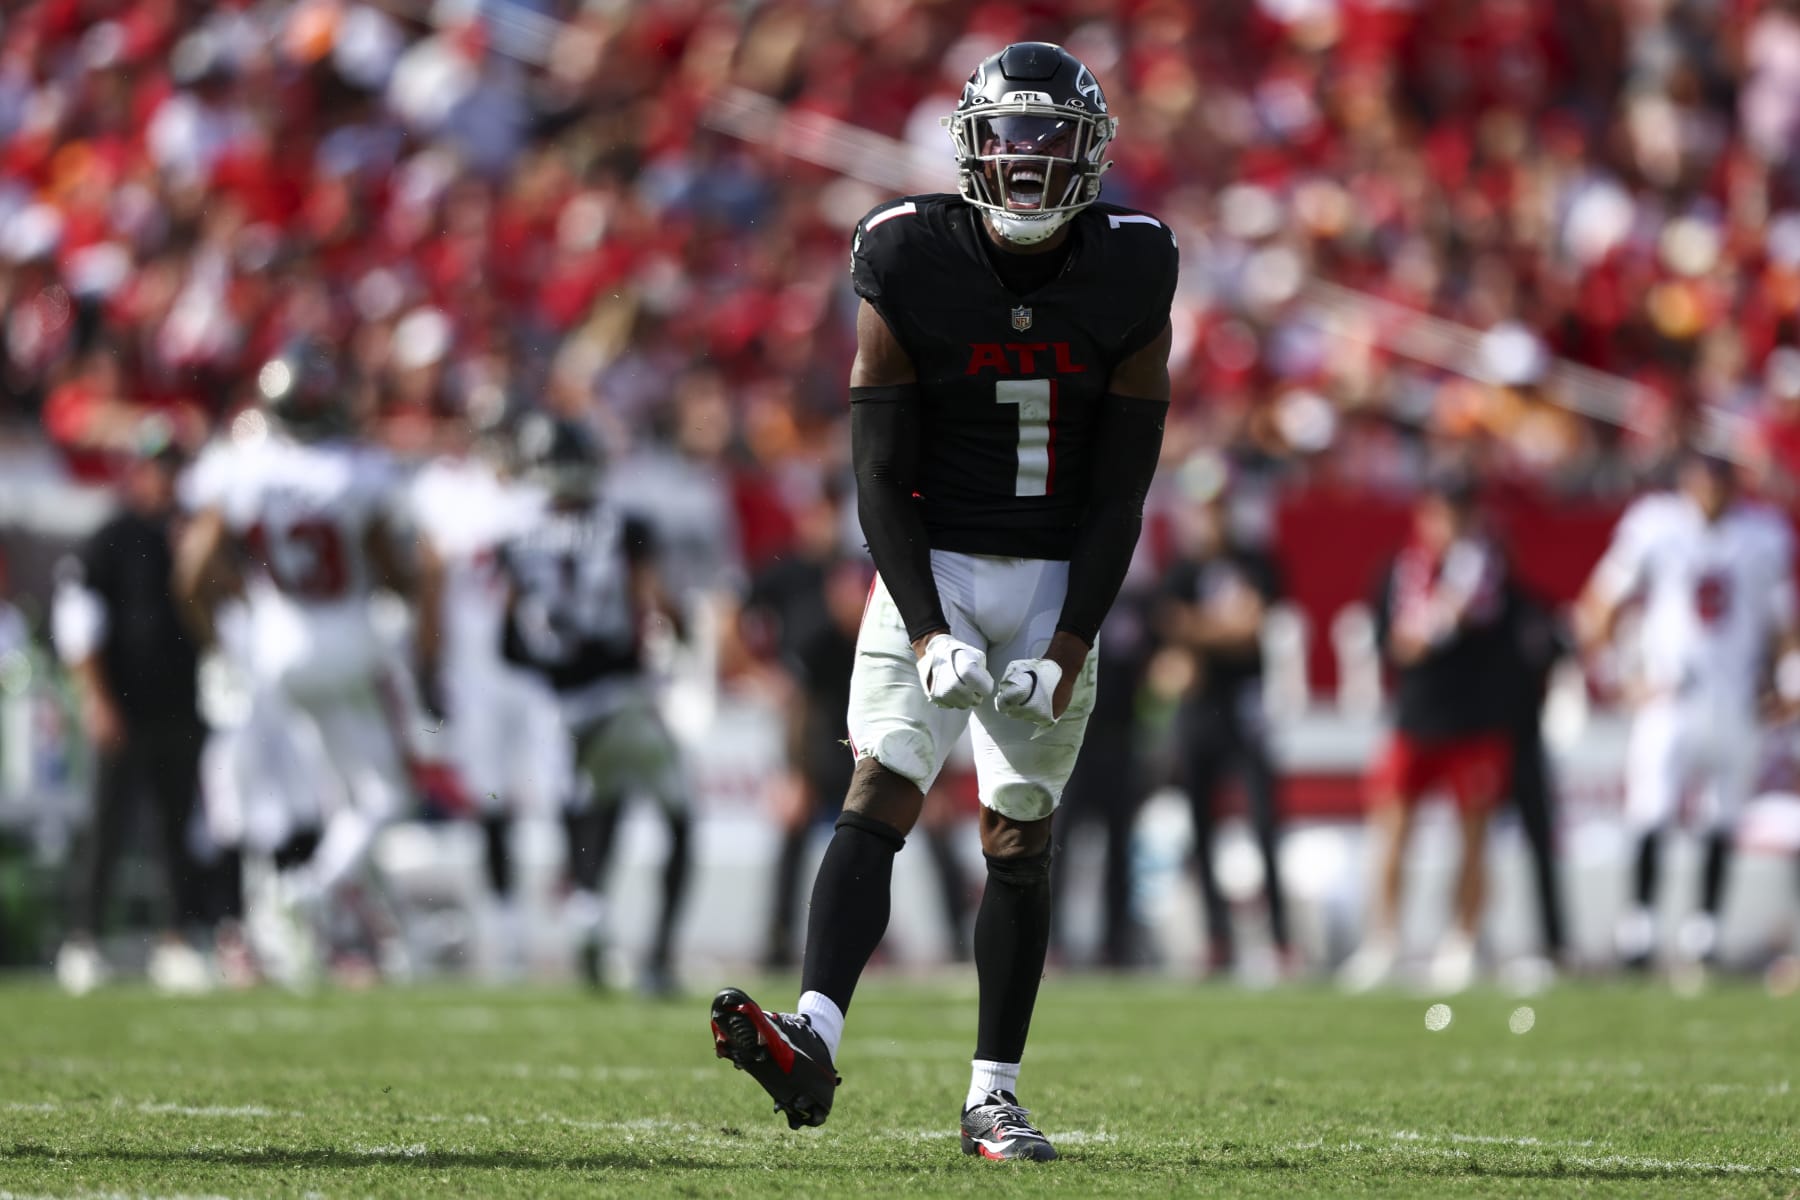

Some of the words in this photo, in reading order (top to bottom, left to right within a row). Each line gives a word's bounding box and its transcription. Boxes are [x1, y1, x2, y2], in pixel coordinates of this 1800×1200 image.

[1013, 92, 1041, 102] ATL
[865, 201, 917, 232] 1
[1107, 214, 1162, 229] 1
[964, 342, 1088, 375] ATL
[996, 379, 1057, 497] 1
